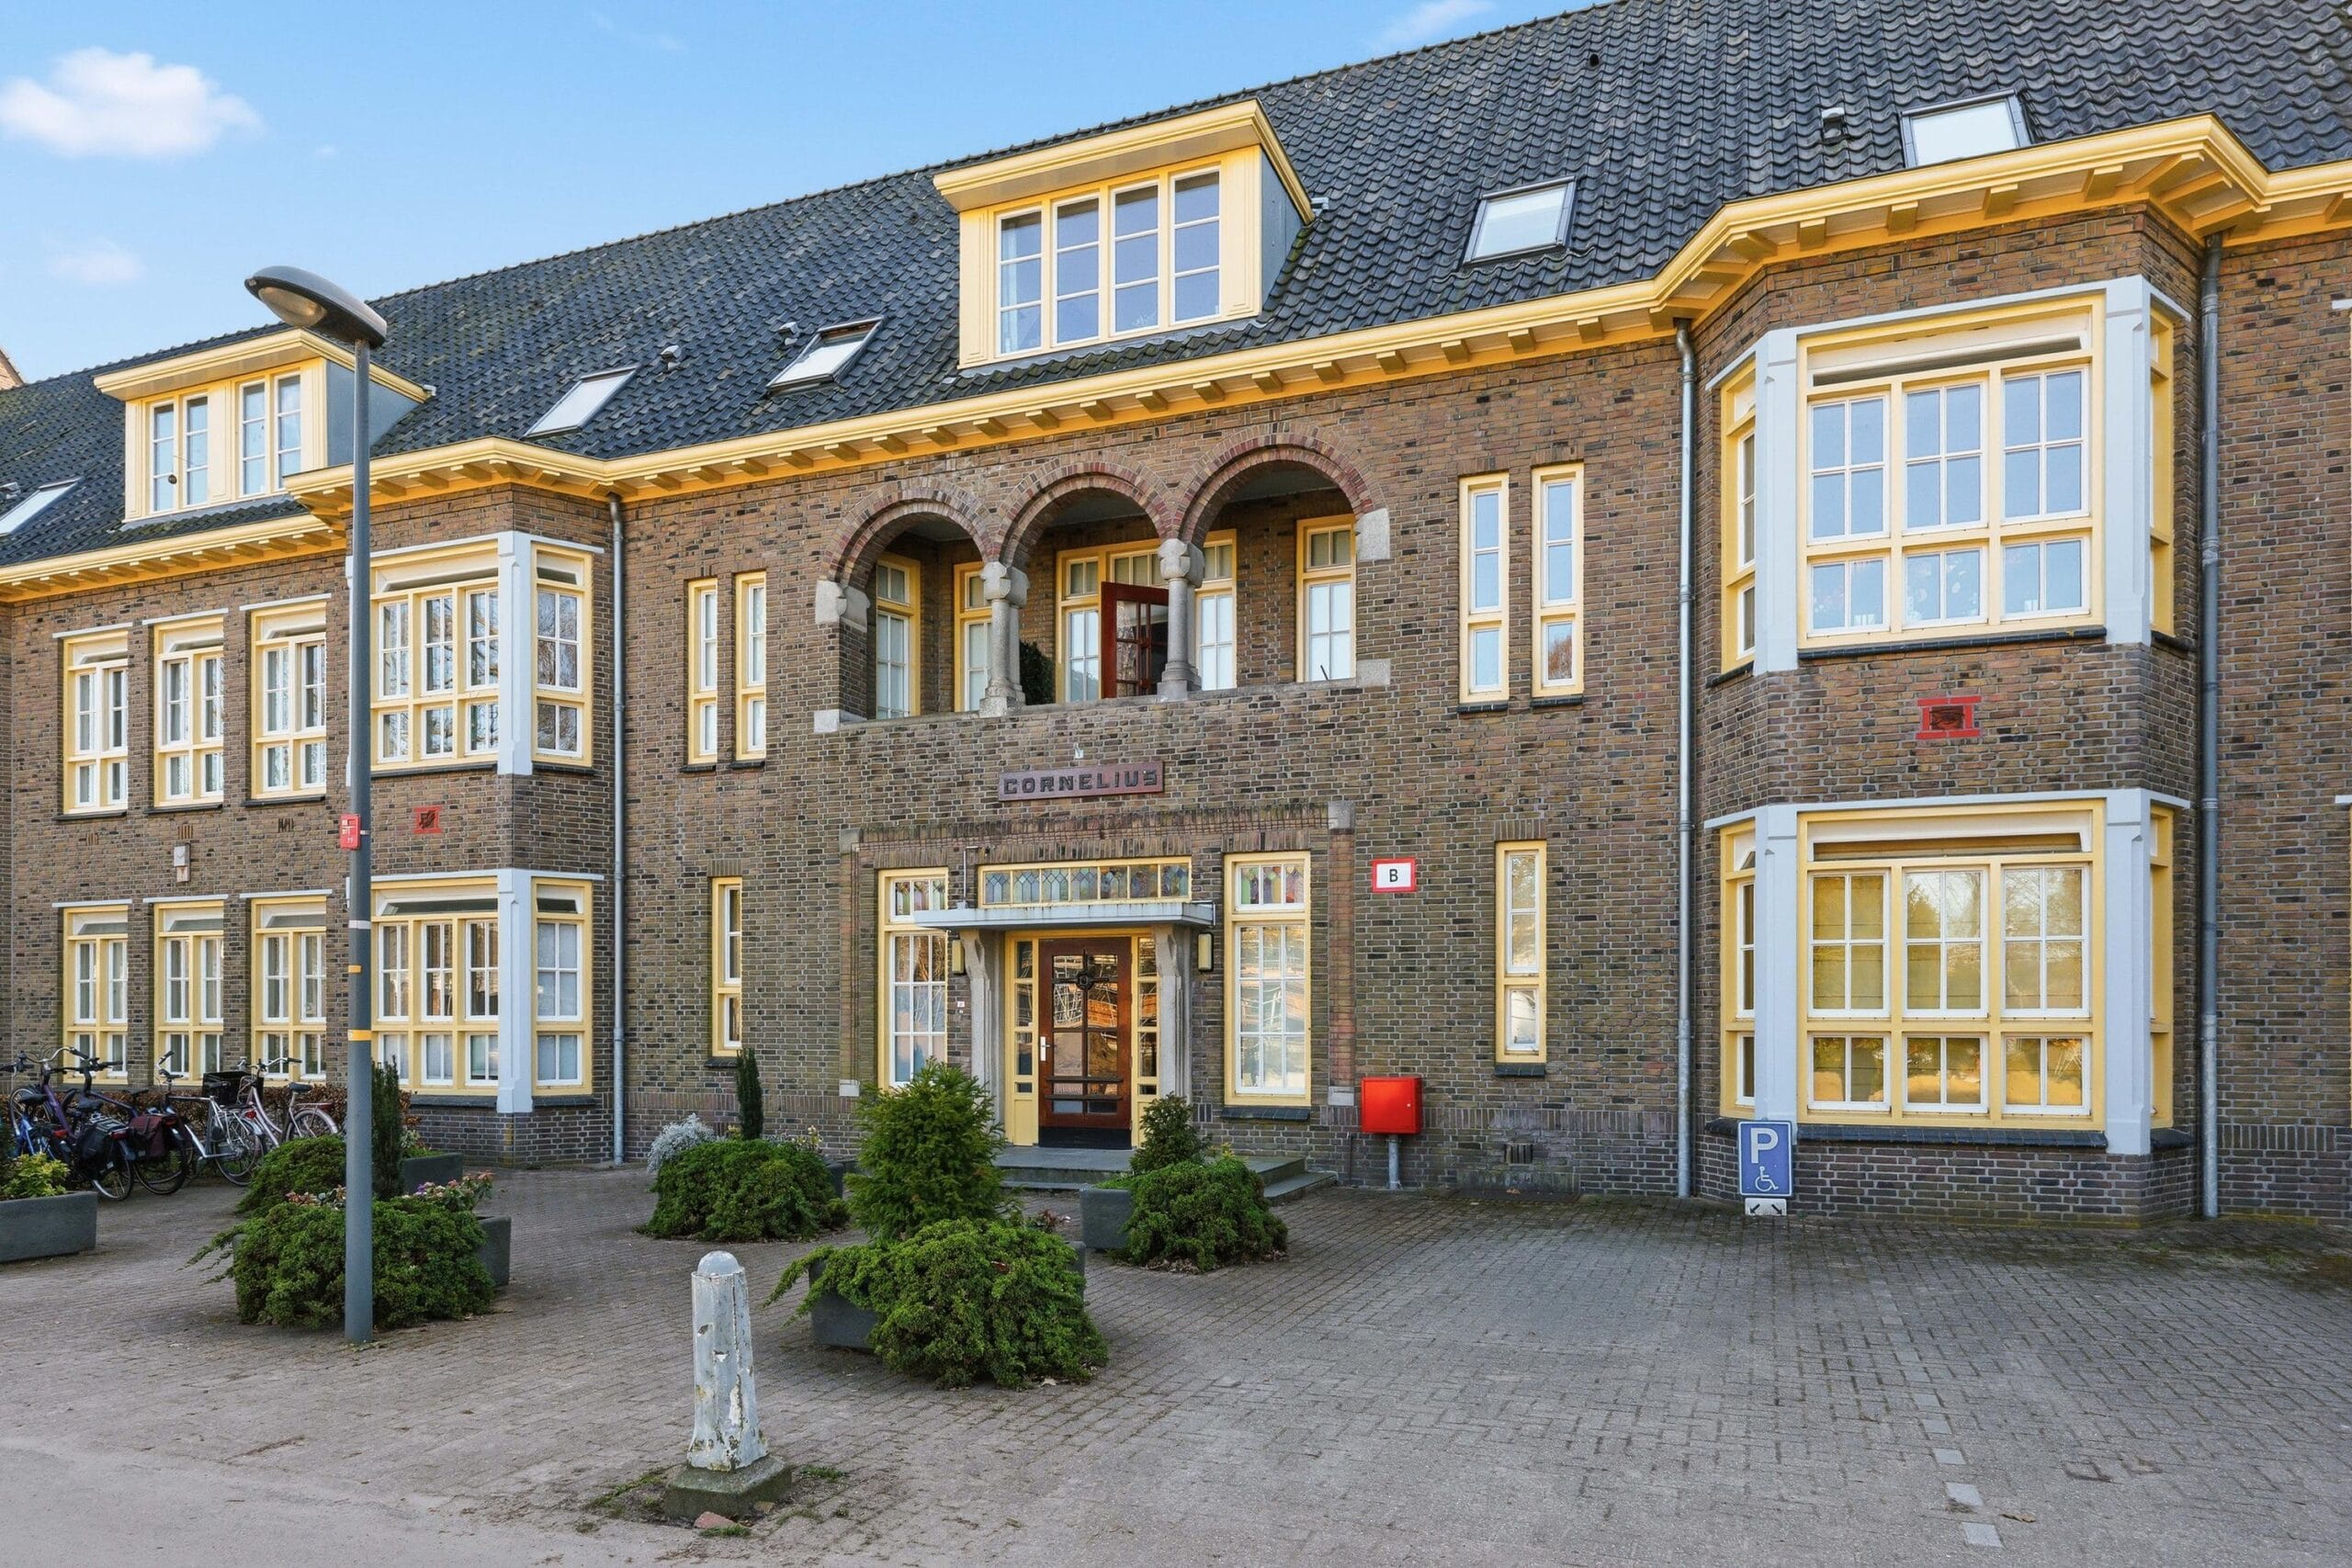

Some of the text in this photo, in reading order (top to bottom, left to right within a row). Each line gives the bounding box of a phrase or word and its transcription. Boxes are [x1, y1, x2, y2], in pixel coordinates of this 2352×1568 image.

[1003, 769, 1158, 795] CORNELIUS
[1389, 868, 1398, 883] B
[1750, 1127, 1779, 1164] P
